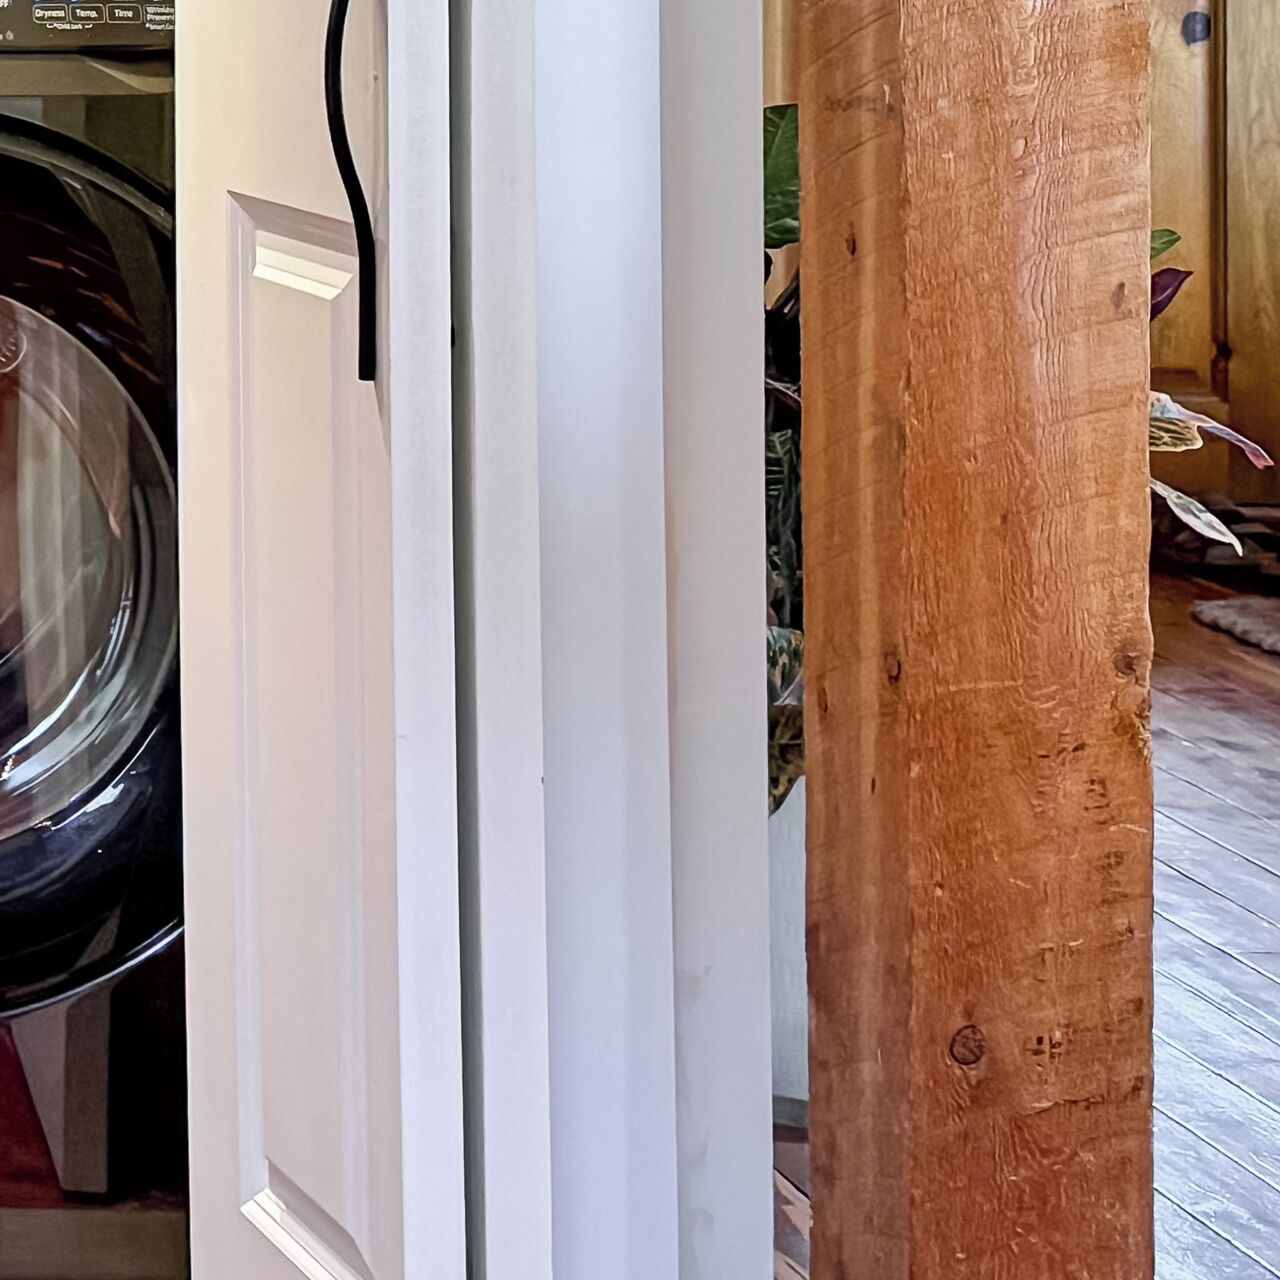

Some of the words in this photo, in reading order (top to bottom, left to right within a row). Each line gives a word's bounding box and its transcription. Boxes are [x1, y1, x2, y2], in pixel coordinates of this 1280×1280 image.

[35, 9, 65, 18] Dryness
[76, 9, 98, 18] Temp.
[114, 9, 133, 18] Time
